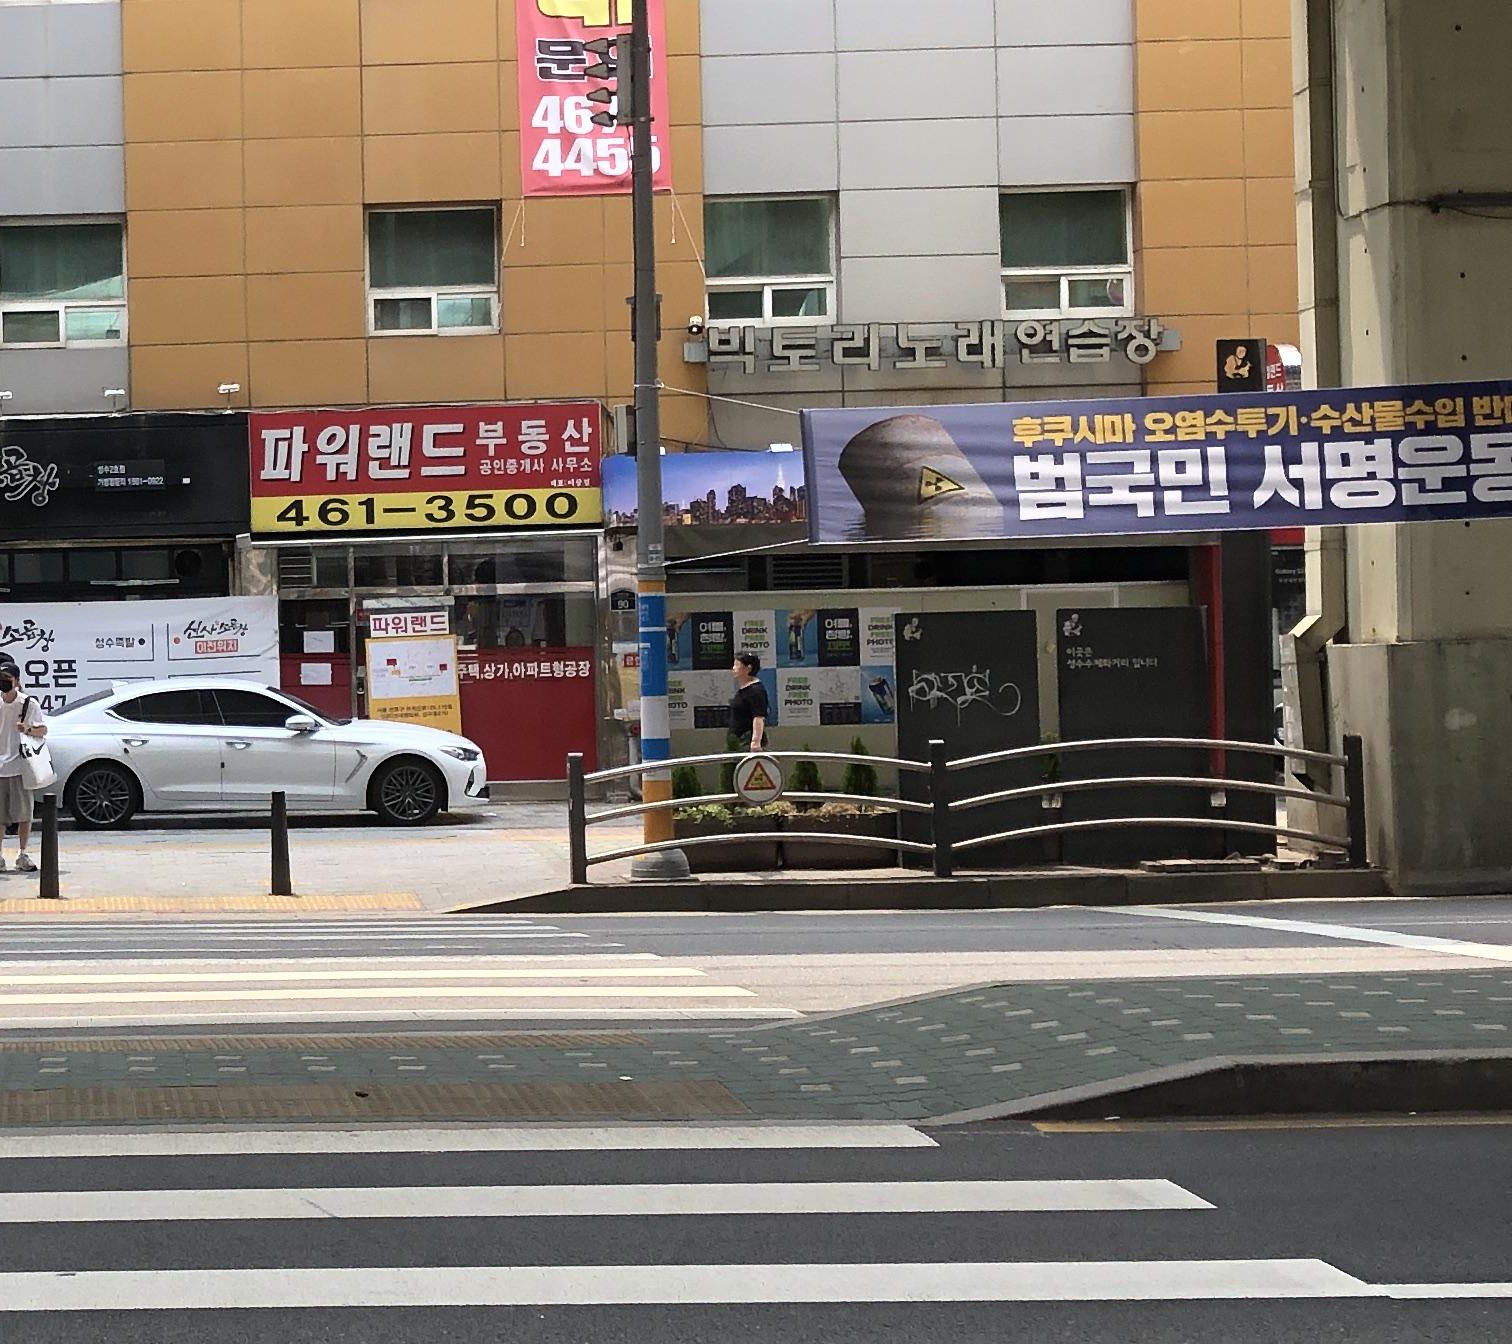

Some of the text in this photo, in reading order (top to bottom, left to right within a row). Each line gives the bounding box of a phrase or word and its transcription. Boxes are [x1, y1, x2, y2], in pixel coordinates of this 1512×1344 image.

[1012, 413, 1135, 448] 후쿠시마
[1472, 394, 1512, 427] 반
[260, 417, 593, 483] 파워랜드 부동산
[479, 456, 592, 475] 공인중개사 사무소
[1012, 445, 1231, 520] 범국민
[276, 491, 579, 527] 461-3500
[372, 614, 447, 634] 파워랜드
[741, 641, 770, 649] PHOTO
[24, 659, 78, 688] 오픈
